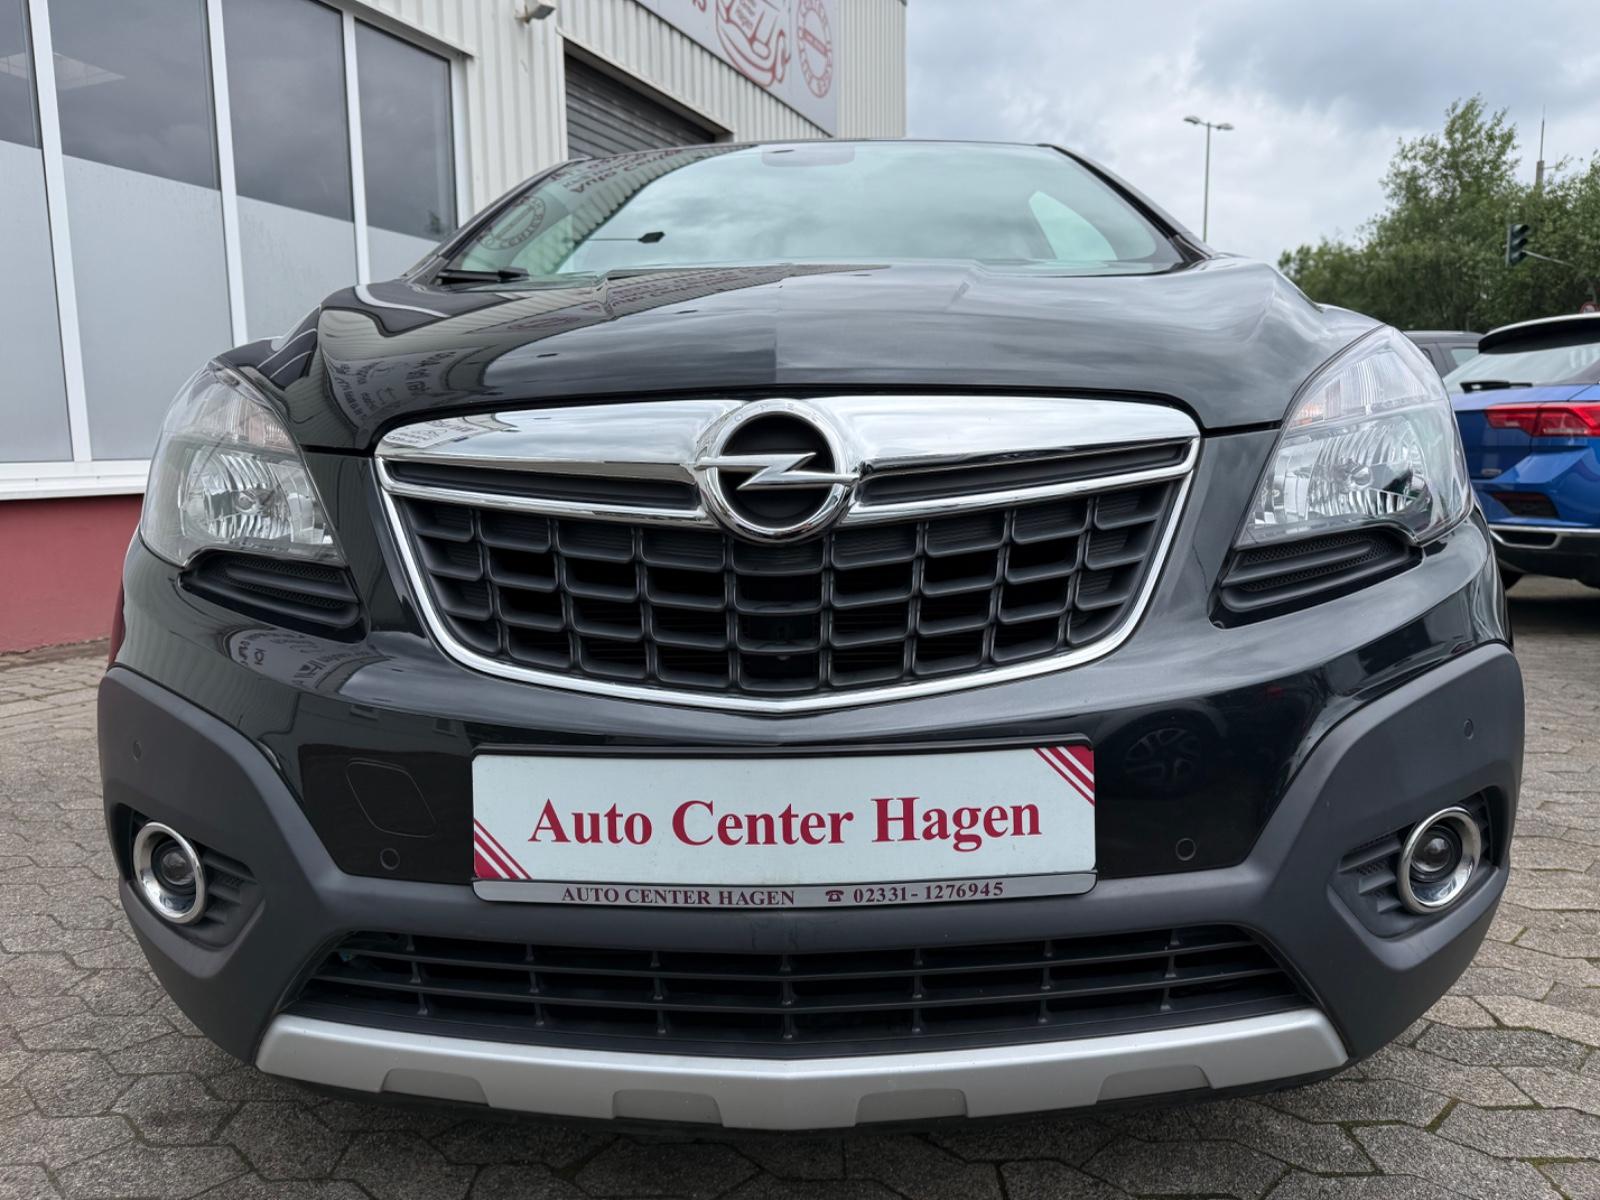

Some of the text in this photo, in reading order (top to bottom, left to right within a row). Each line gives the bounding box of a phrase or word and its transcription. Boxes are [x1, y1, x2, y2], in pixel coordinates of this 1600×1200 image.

[528, 796, 1042, 853] Auto Center Hagen
[561, 887, 619, 903] AUTO
[625, 888, 711, 905] CENTER
[718, 890, 796, 906] HAGEN
[924, 880, 1004, 900] 1276945
